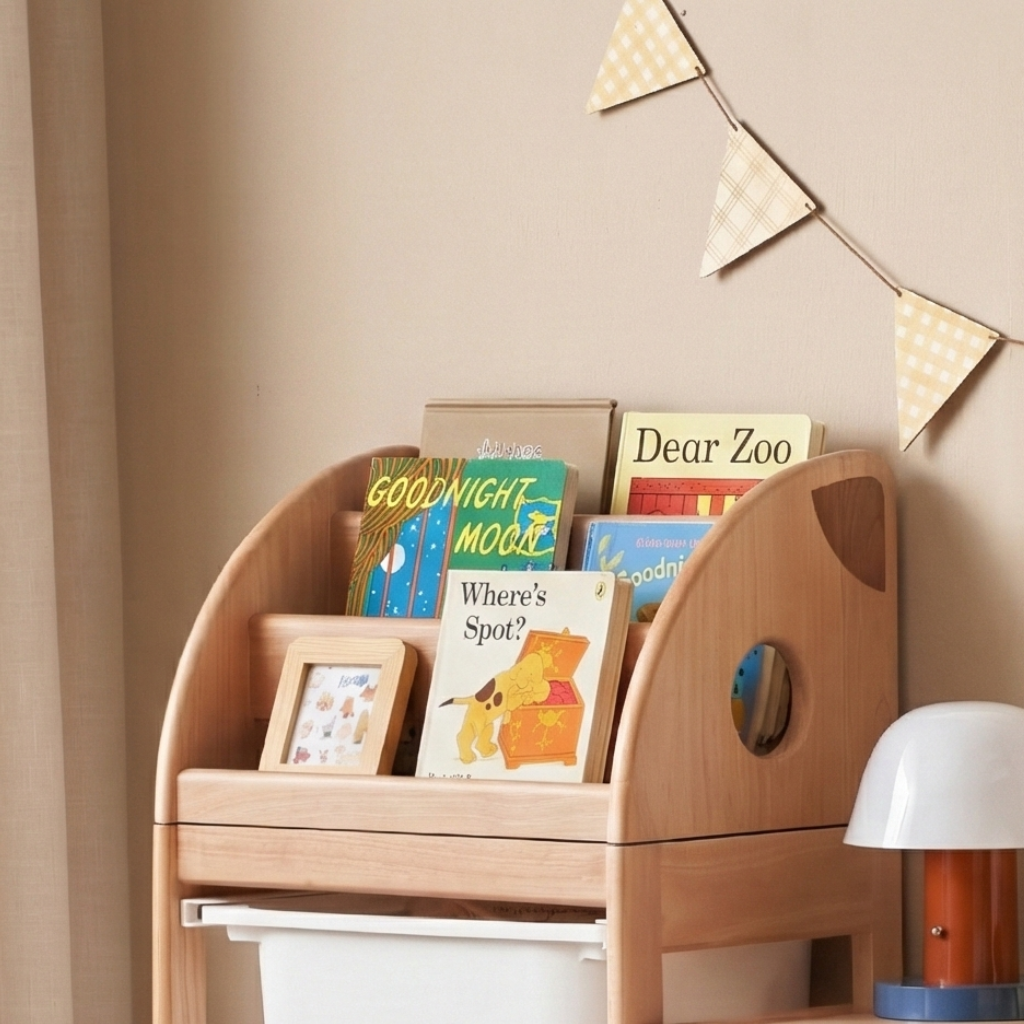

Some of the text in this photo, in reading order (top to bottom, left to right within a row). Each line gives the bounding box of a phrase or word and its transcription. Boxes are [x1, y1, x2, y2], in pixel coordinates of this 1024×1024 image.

[633, 427, 792, 464] Dear Zoo
[367, 476, 537, 509] GOODNIGHT
[454, 522, 541, 555] MOON
[461, 581, 547, 607] Where's
[463, 615, 527, 646] Spot?
